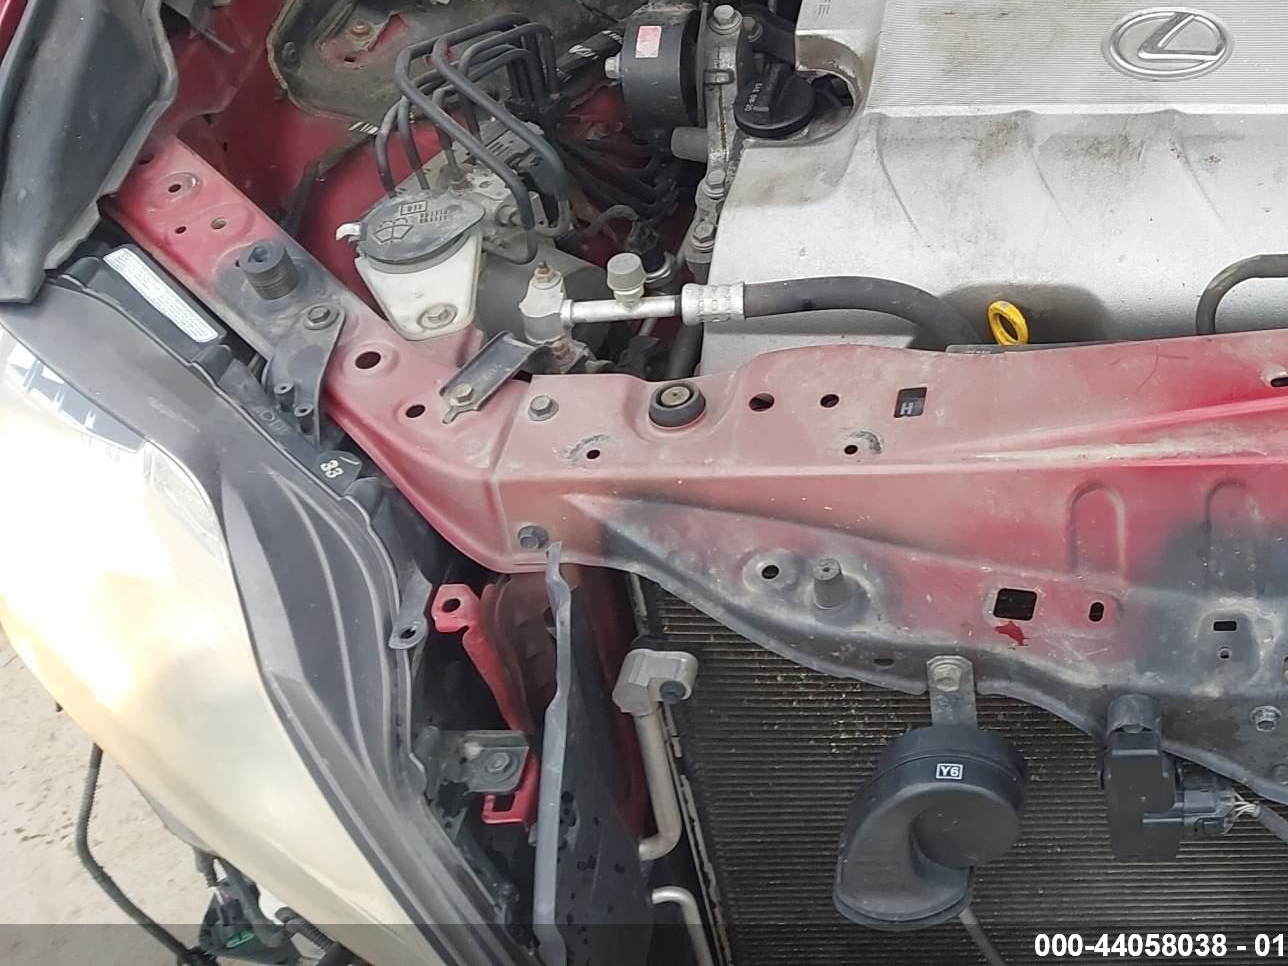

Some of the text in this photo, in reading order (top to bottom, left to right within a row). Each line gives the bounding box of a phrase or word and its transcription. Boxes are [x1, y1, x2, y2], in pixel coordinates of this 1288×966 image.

[899, 401, 914, 416] H
[319, 459, 344, 479] 33
[940, 765, 960, 778] Y6
